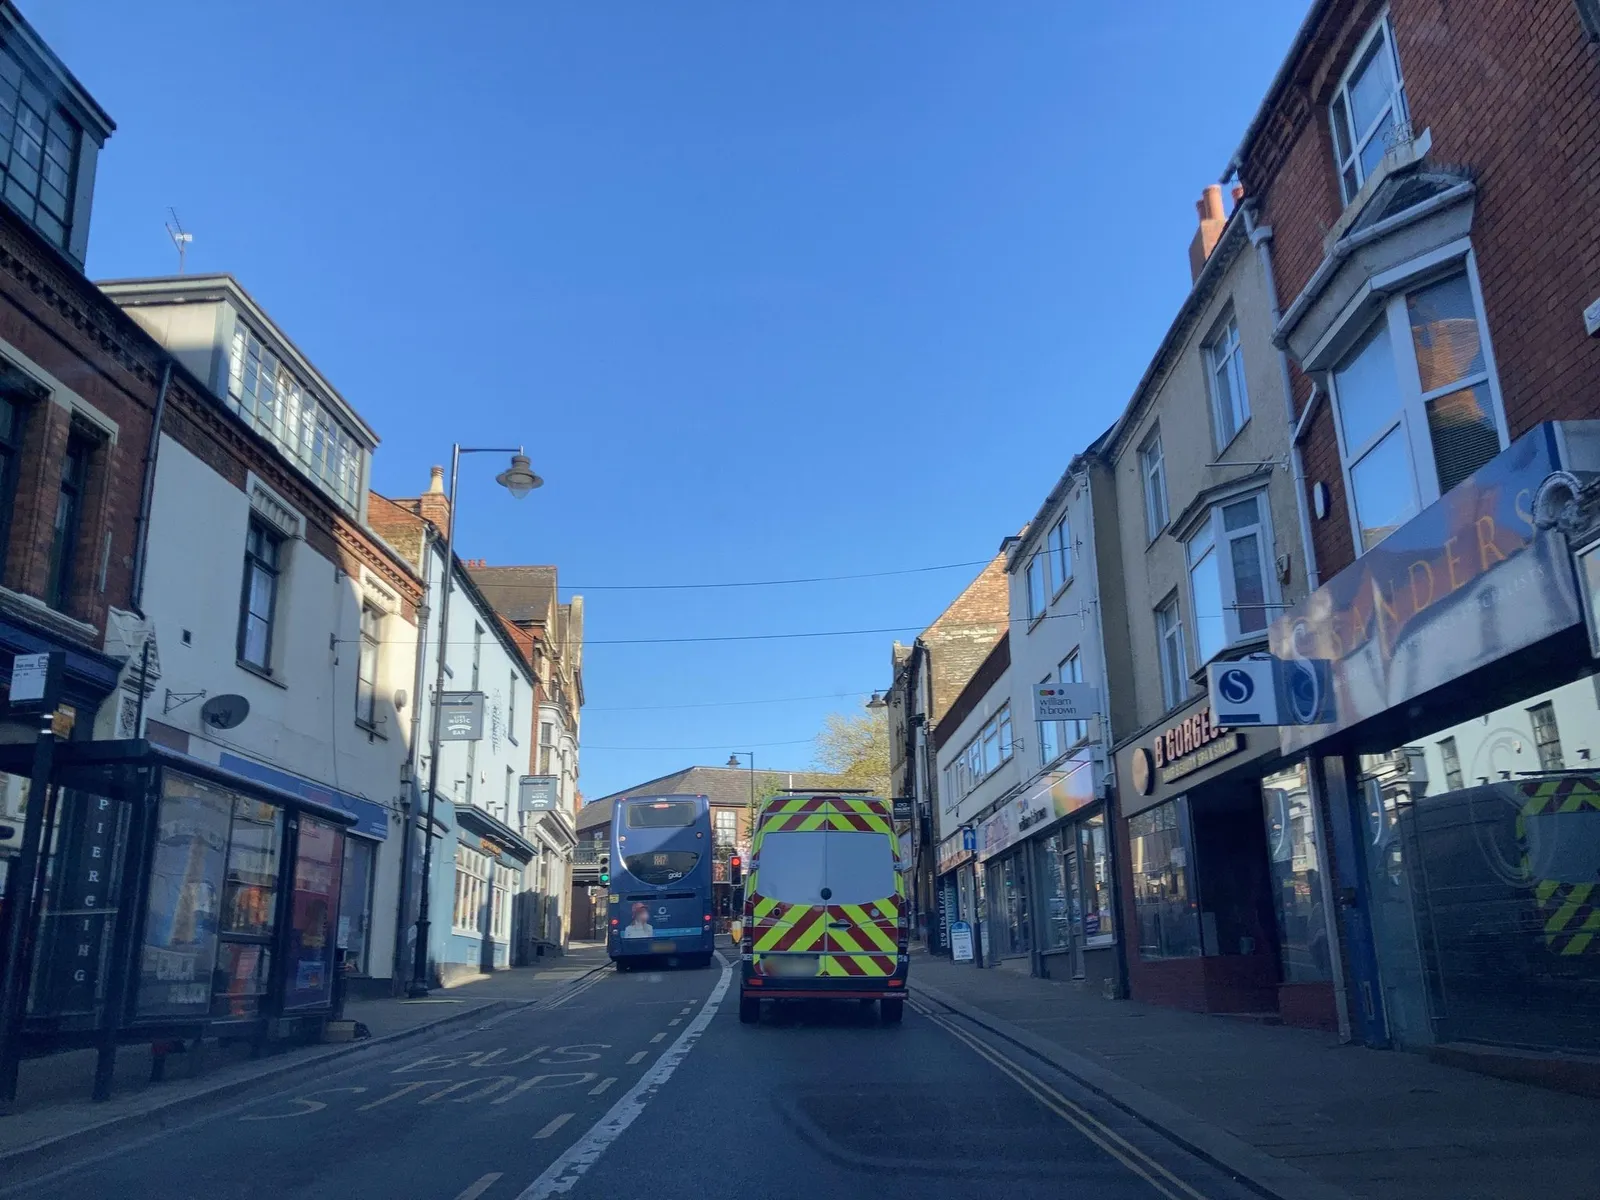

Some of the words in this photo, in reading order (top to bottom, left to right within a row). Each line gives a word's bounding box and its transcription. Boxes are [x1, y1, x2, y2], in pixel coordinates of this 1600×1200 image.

[1039, 697, 1072, 706] william
[1225, 671, 1247, 702] S
[1047, 706, 1077, 715] brown
[1154, 735, 1164, 769] B
[1166, 706, 1229, 761] GORGE
[74, 799, 109, 982] PIERCING
[390, 1044, 612, 1074] BUS
[238, 1072, 598, 1122] STOP
